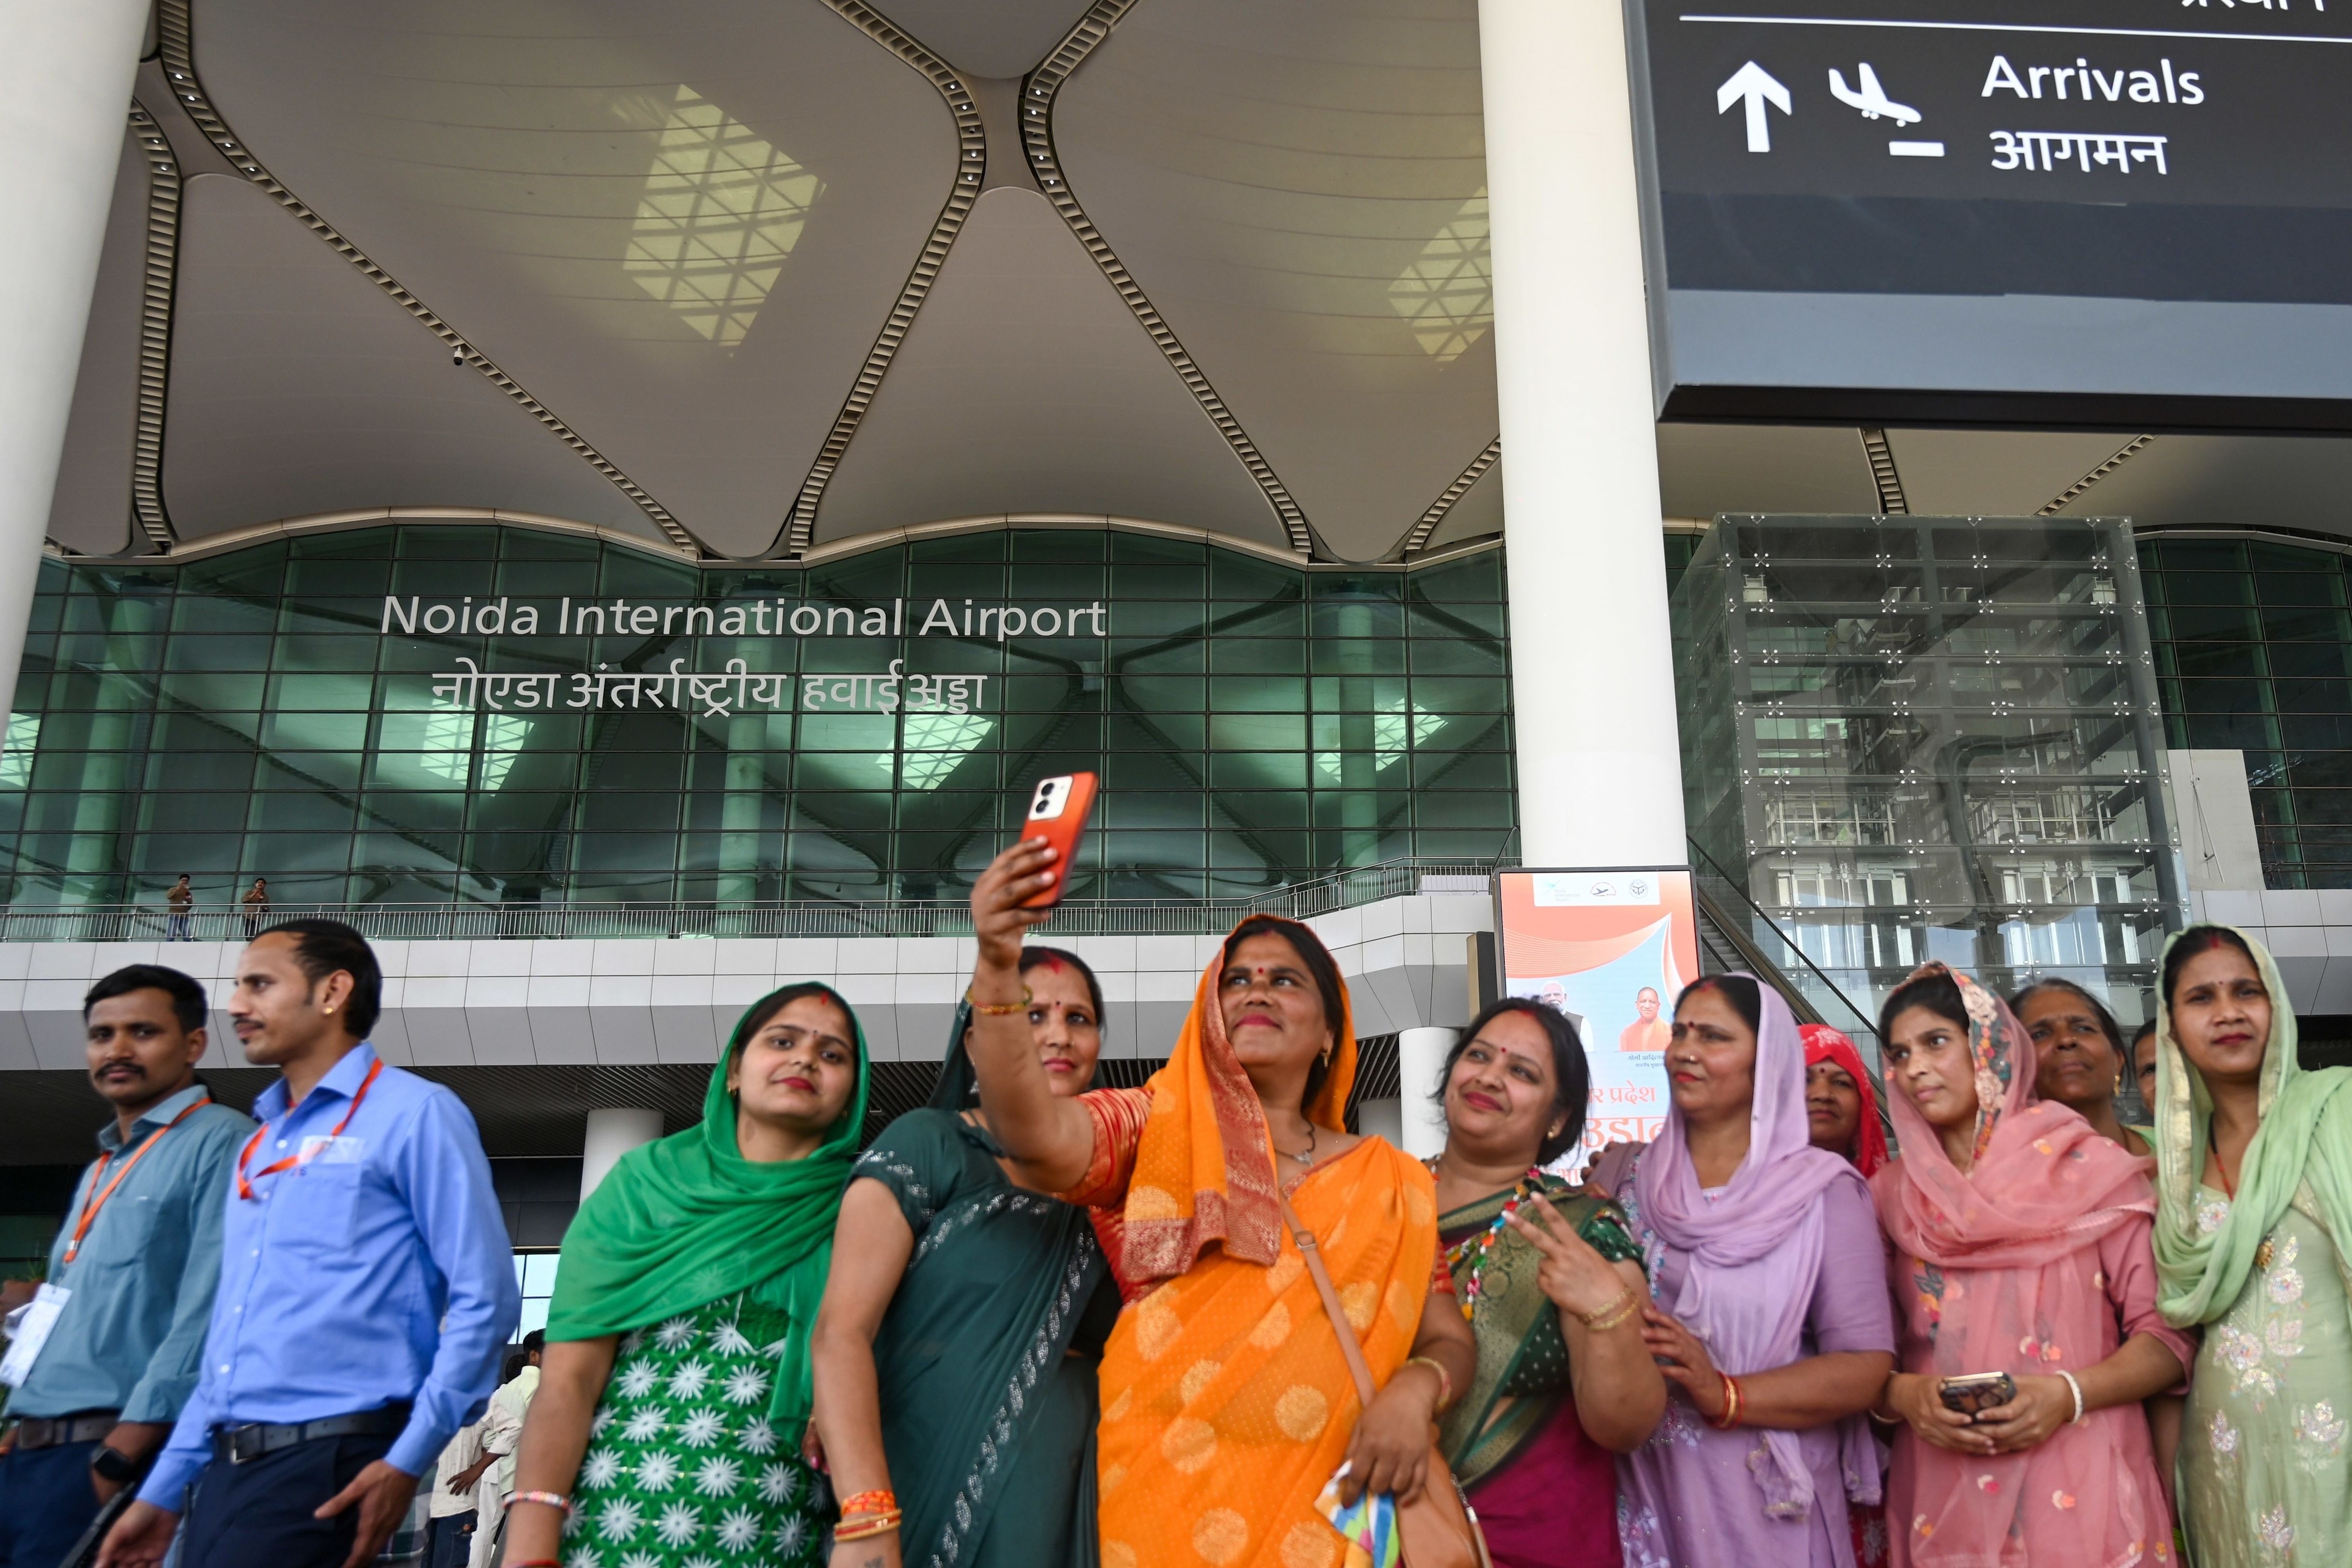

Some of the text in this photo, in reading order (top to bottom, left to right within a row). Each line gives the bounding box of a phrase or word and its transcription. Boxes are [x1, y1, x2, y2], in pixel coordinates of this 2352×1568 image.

[1981, 55, 2204, 105] Arrivals
[1989, 130, 2168, 175] आगमन
[381, 596, 1106, 642] Noida International Airport
[432, 656, 562, 710] नोएडा
[566, 657, 787, 718] अंतर्राष्ट्रीय
[801, 658, 904, 716] हवाई
[1609, 1080, 1656, 1105] प्रदेश
